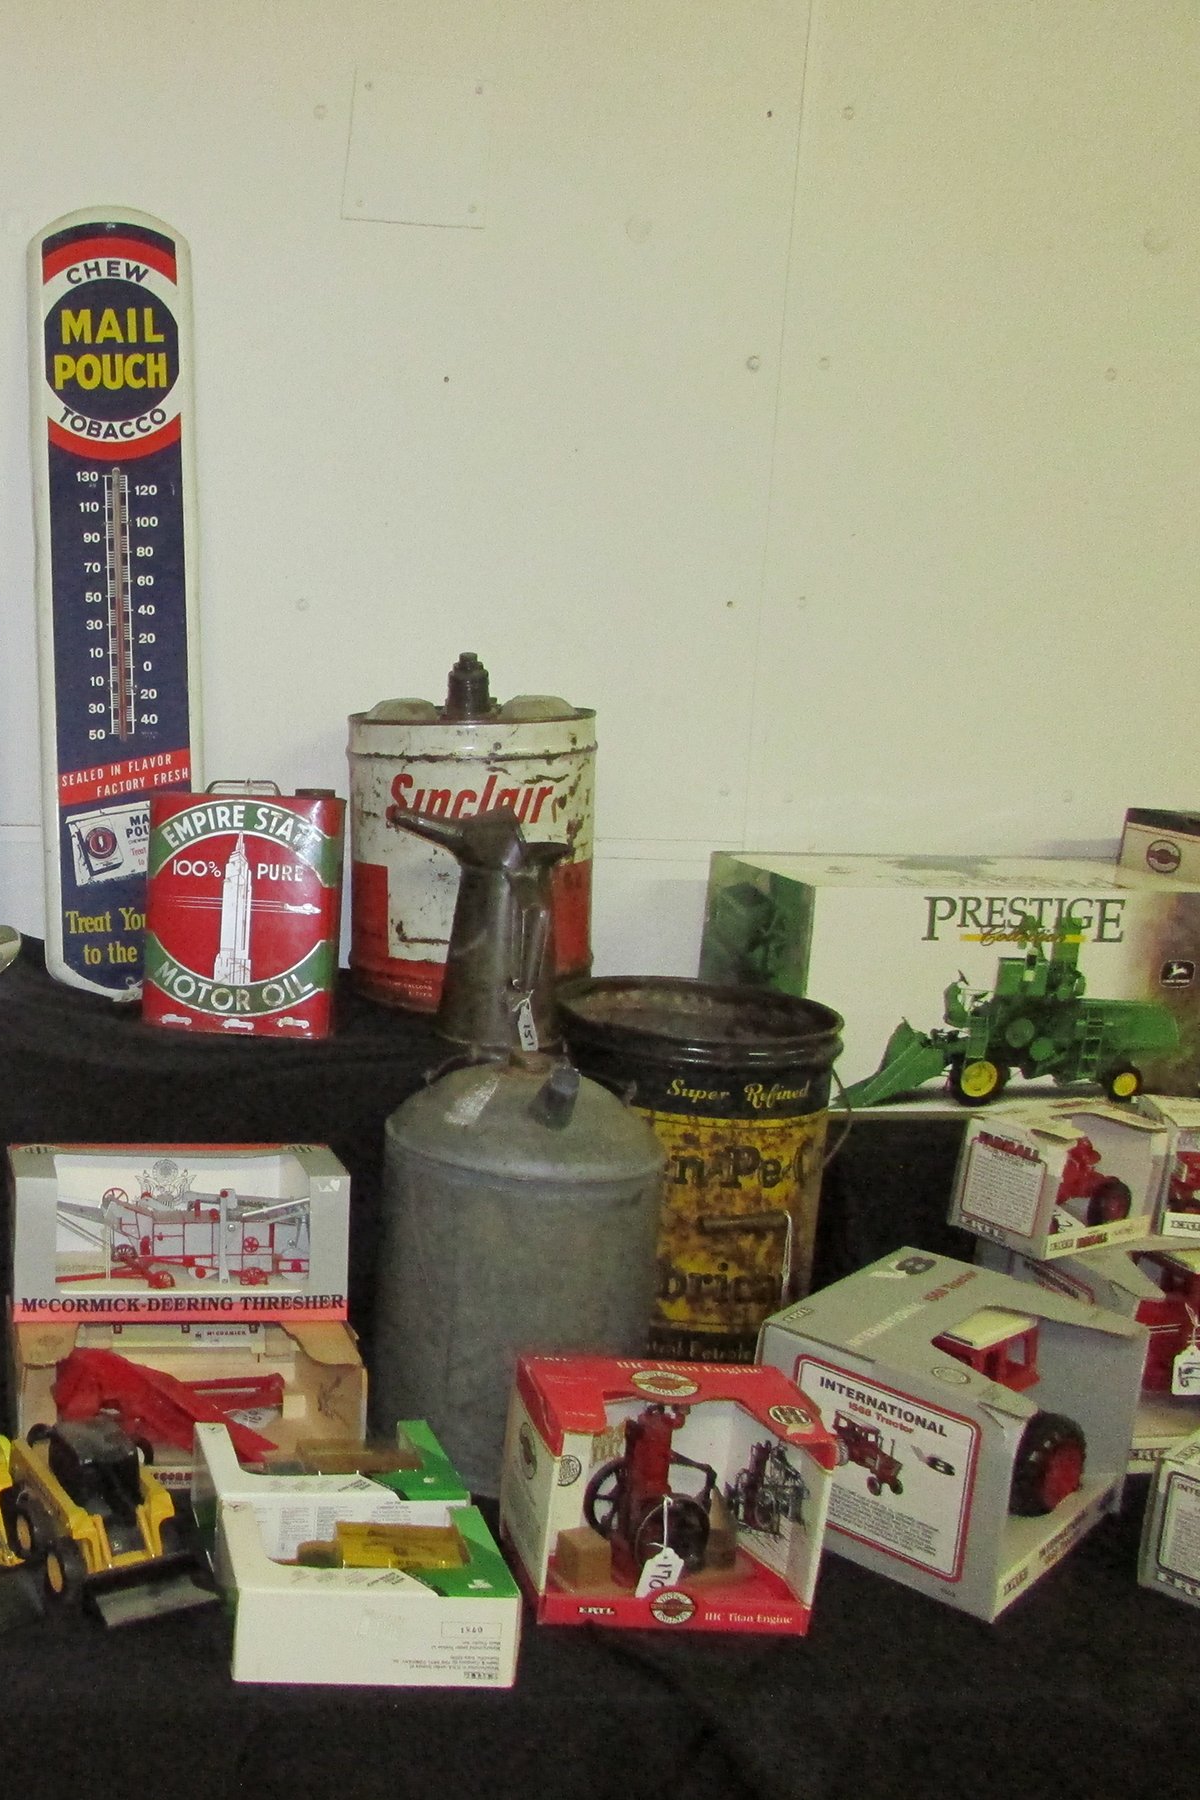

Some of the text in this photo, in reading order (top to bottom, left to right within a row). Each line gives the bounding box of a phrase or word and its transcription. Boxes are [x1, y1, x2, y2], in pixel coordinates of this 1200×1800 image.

[66, 260, 150, 285] CHEW
[61, 307, 165, 345] MAIL
[54, 352, 167, 390] POUCH
[59, 406, 167, 440] TOBACCO
[76, 471, 99, 482] 130
[134, 485, 158, 496] 120
[79, 502, 99, 513] 110
[135, 517, 158, 527] 100
[83, 532, 101, 543] 90
[136, 546, 154, 557] 80
[84, 562, 101, 573] 70
[137, 576, 154, 586] 60
[85, 592, 102, 603] 50
[137, 605, 155, 615] 40
[86, 620, 103, 630] 30
[138, 633, 156, 644] 20
[89, 648, 103, 658] 10
[143, 661, 152, 671] 0
[90, 676, 104, 686] 10
[140, 689, 157, 699] 20
[88, 703, 105, 714] 30
[140, 714, 158, 724] 40
[88, 730, 106, 740] 50
[62, 754, 172, 788] SEALED IN FLAVOR
[97, 768, 189, 798] FACTORY FRESH
[386, 773, 558, 829] Sinclair
[129, 814, 149, 826] MA
[126, 825, 149, 838] POU
[162, 805, 246, 849] EMPIRE
[254, 807, 322, 851] STATE
[173, 859, 304, 882] 100% PURE
[66, 910, 112, 935] Treat
[922, 896, 1126, 943] PRESTIGE
[84, 941, 138, 965] to the
[155, 960, 314, 1011] MOTOR OIL
[666, 1079, 810, 1109] Super Refined
[21, 1294, 345, 1313] McCORMICK-DEERING THRESHER
[819, 1375, 949, 1438] INTERNATIONAL
[577, 1606, 615, 1616] ERTL
[728, 1613, 753, 1623] Titan
[756, 1614, 793, 1626] Engine
